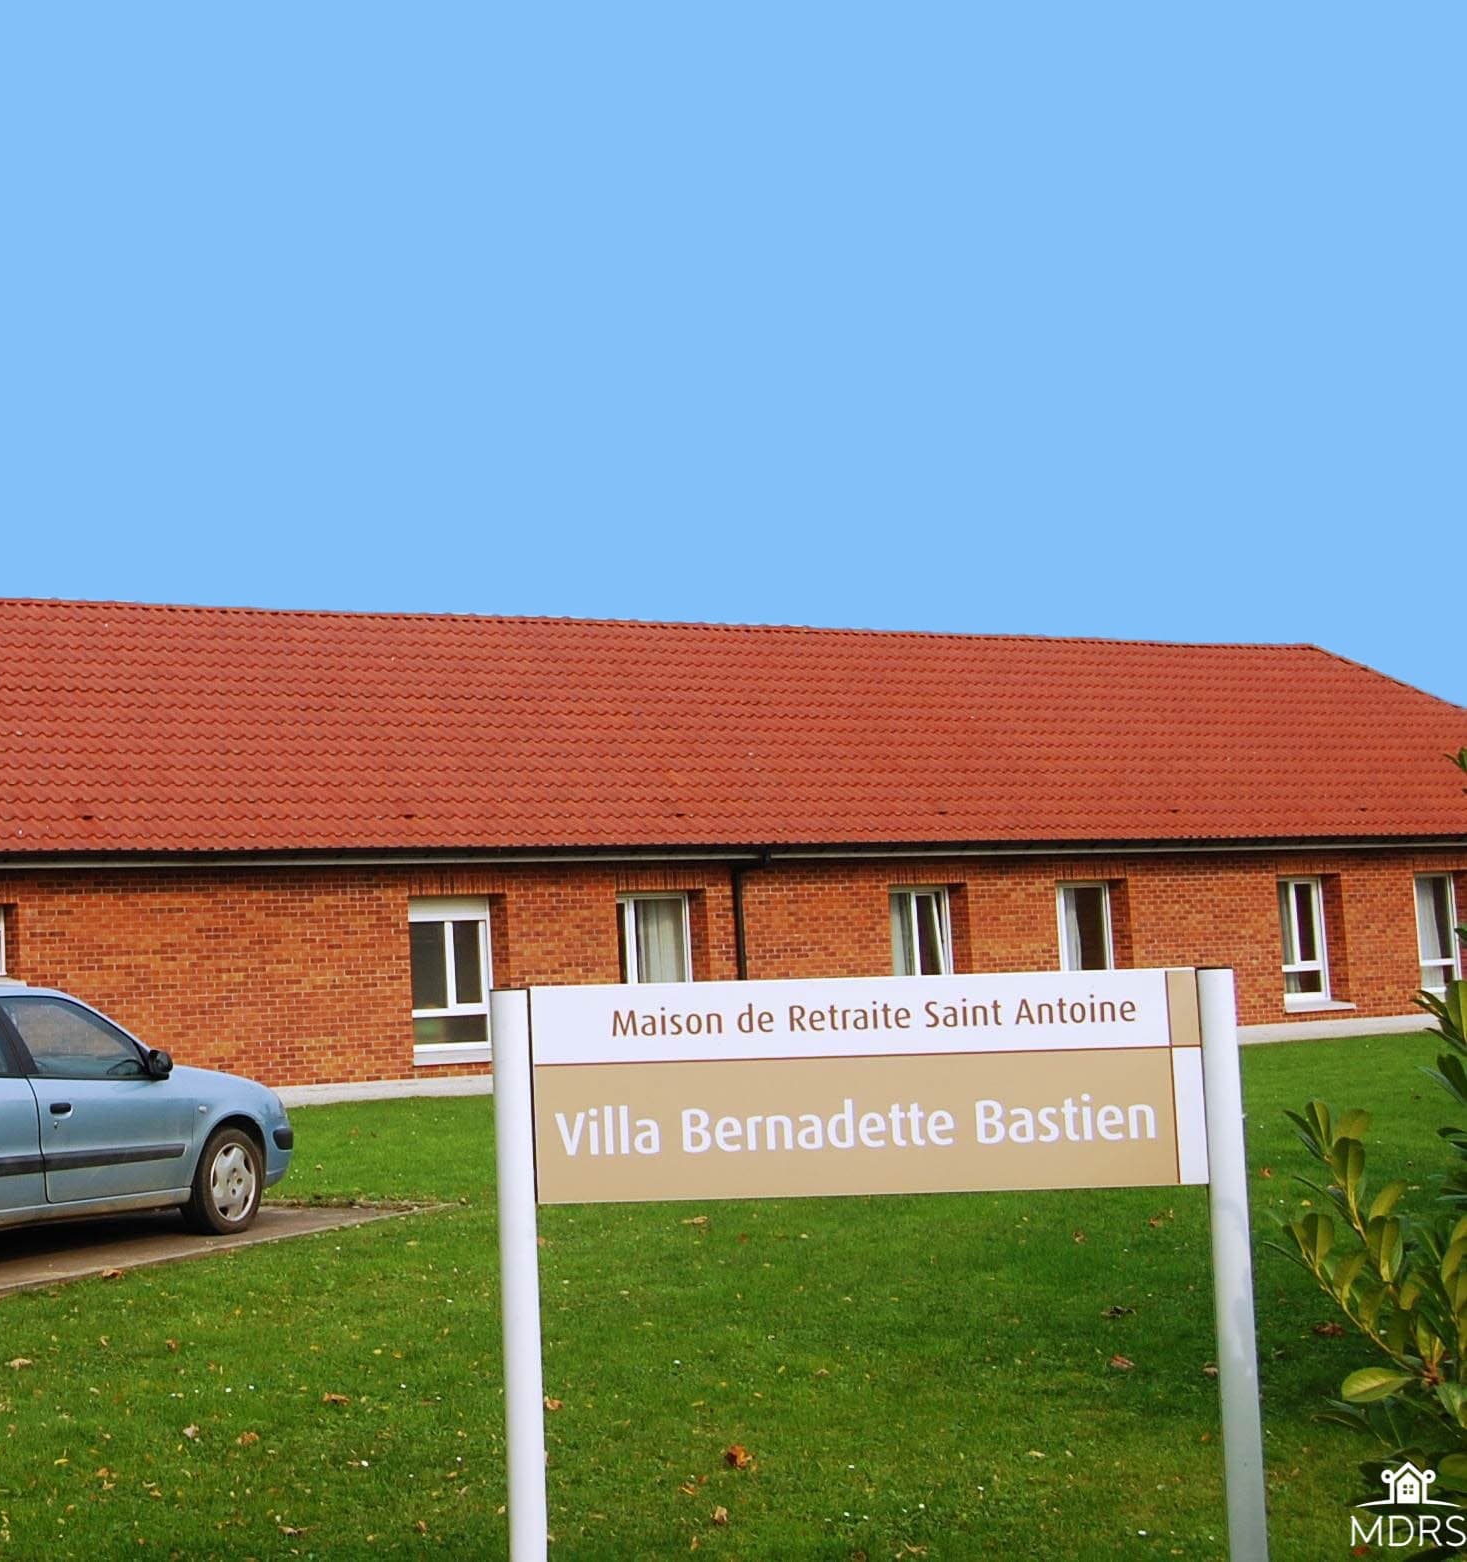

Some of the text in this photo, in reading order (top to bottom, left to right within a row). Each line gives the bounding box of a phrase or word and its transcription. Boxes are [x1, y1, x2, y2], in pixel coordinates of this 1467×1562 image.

[612, 995, 1137, 1038] Maison de Retraite Saint Antoine
[554, 1093, 1157, 1157] Villa Bernadette Bastien
